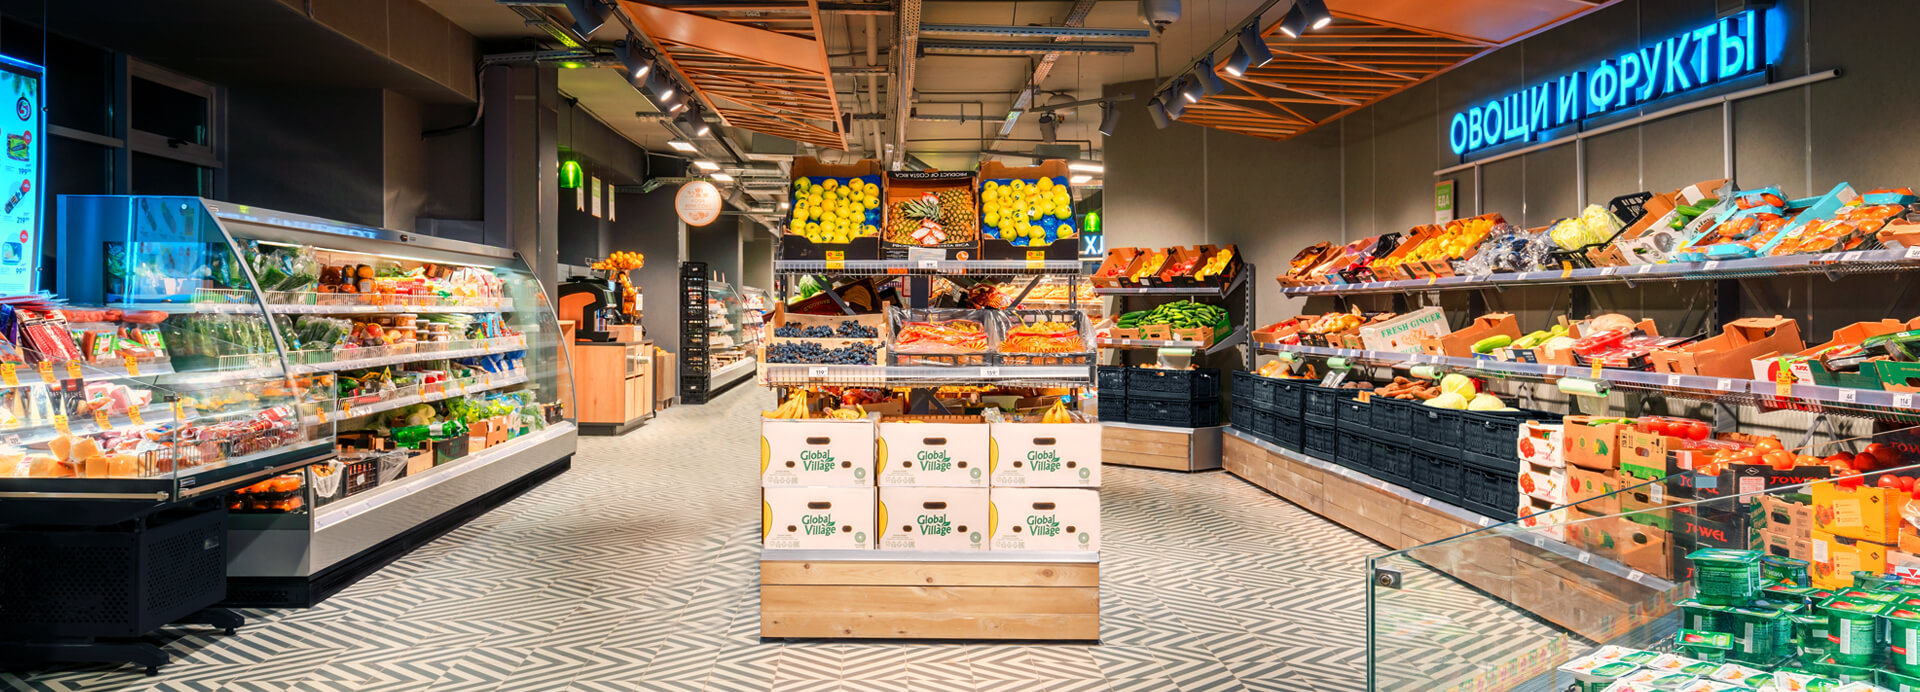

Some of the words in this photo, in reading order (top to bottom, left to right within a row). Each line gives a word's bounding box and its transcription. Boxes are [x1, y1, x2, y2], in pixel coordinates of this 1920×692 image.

[1450, 81, 1550, 155] ОВОЩИ
[1557, 71, 1580, 124] И
[1589, 10, 1756, 113] ФРУКТЫ
[1438, 193, 1450, 209] ЕДА
[1381, 323, 1409, 338] FRESH
[1410, 311, 1443, 328] GINGER
[800, 449, 831, 461] Global
[917, 450, 947, 462] Global
[1027, 451, 1057, 462] Global
[803, 460, 835, 473] Village
[920, 461, 952, 473] Village
[1030, 461, 1061, 473] Village
[801, 514, 832, 526] Global
[917, 514, 947, 526] Global
[1027, 515, 1057, 526] Global
[804, 525, 836, 537] Village
[920, 525, 952, 537] Village
[1029, 525, 1060, 537] Village
